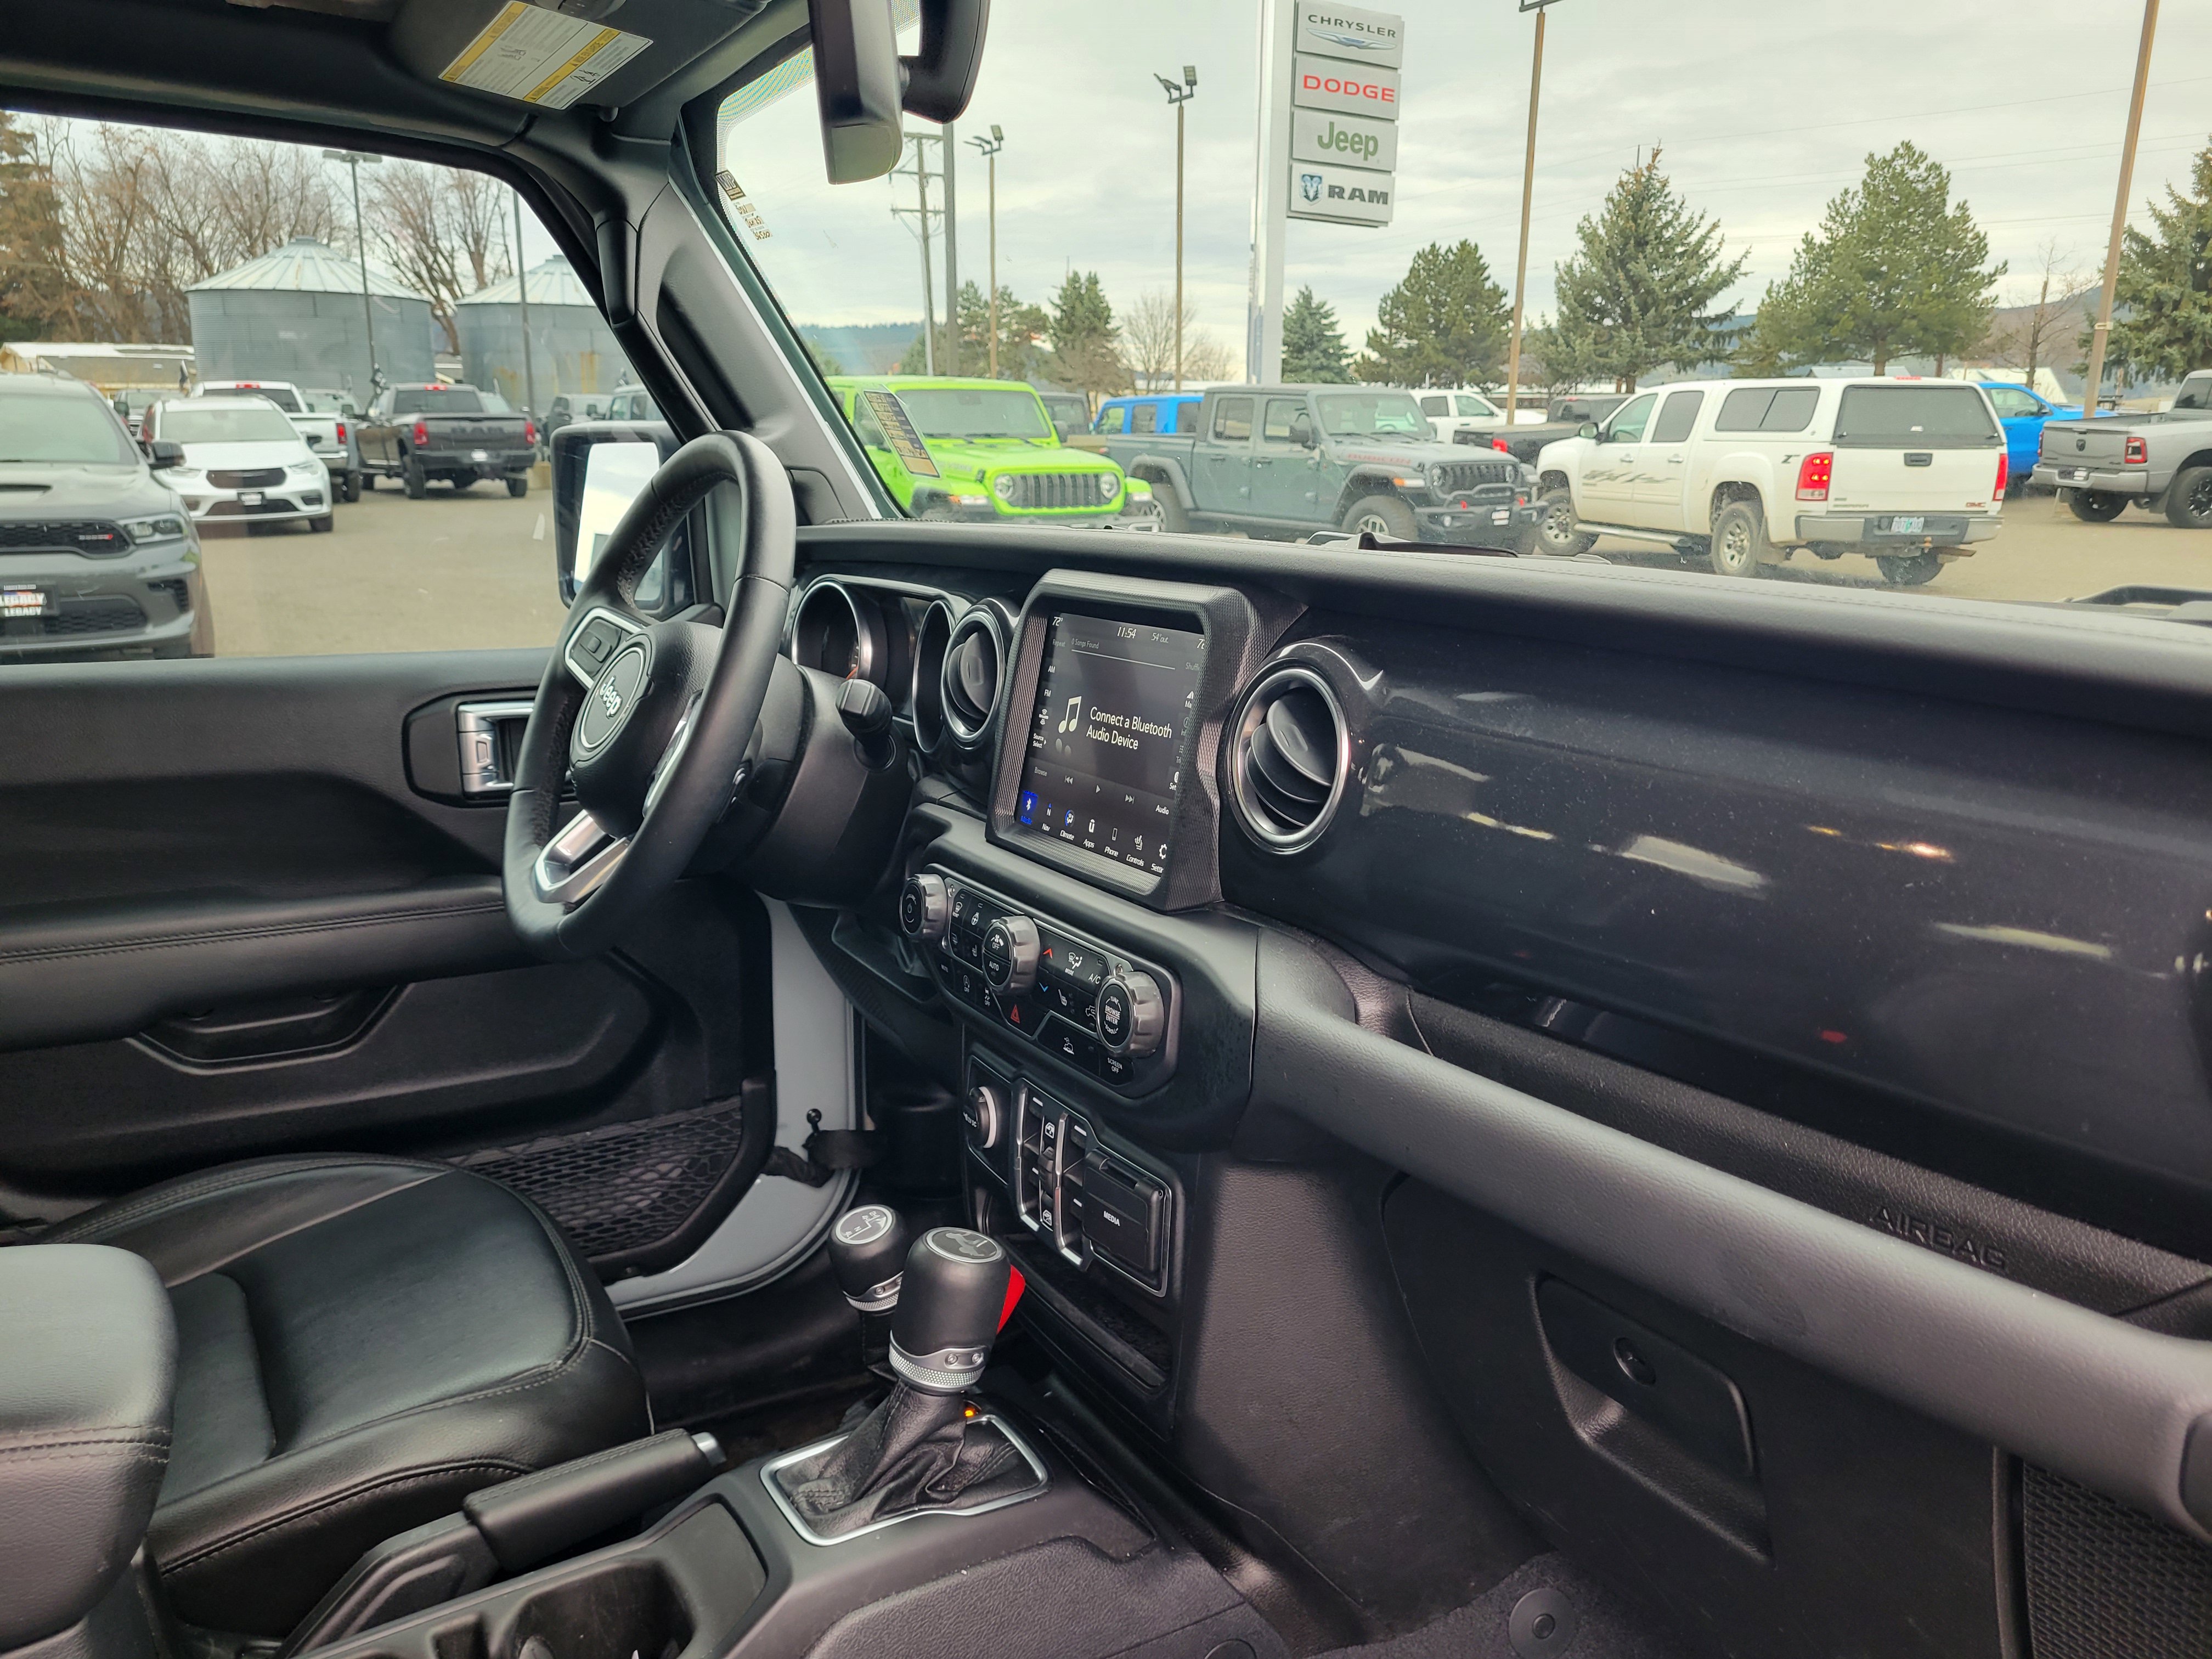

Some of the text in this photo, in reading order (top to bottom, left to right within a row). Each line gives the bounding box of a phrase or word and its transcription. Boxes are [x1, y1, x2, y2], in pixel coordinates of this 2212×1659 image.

[1308, 14, 1396, 38] CHRYSLER
[1304, 75, 1395, 103] DODGE
[1318, 122, 1378, 161] Jeep
[1328, 184, 1389, 205] RAM
[1052, 616, 1063, 627] 72°
[1117, 627, 1137, 639] 11:54
[1052, 639, 1066, 647] Repeat
[1075, 639, 1086, 648] Songs
[1087, 641, 1099, 649] Found
[1048, 665, 1056, 674] AM
[599, 675, 623, 719] Jeep
[1044, 689, 1052, 697] FM
[1090, 706, 1172, 739] Connect a Bluetooth
[1033, 733, 1044, 741] Source
[1086, 724, 1138, 750] Audio Device
[1032, 741, 1042, 749] Select
[1034, 767, 1047, 777] Browse
[1155, 804, 1169, 815] Audio
[1042, 823, 1051, 832] Nav
[1060, 830, 1075, 841] Climate
[1082, 838, 1095, 849] Apps
[1104, 847, 1119, 857] Phone
[1126, 854, 1145, 867] Controls
[992, 942, 1000, 950] OFF
[989, 961, 999, 971] AUTO
[1065, 968, 1074, 976] MODE
[1088, 973, 1101, 985] A/C
[1110, 996, 1119, 1005] TUNE
[1105, 1005, 1120, 1017] BROWSE
[1105, 1014, 1118, 1025] ENTER
[1105, 1024, 1117, 1035] SCROLL
[1107, 1057, 1122, 1070] SCREEN
[1103, 1210, 1120, 1227] MEDIA
[1869, 1207, 2006, 1268] AIRBAG
